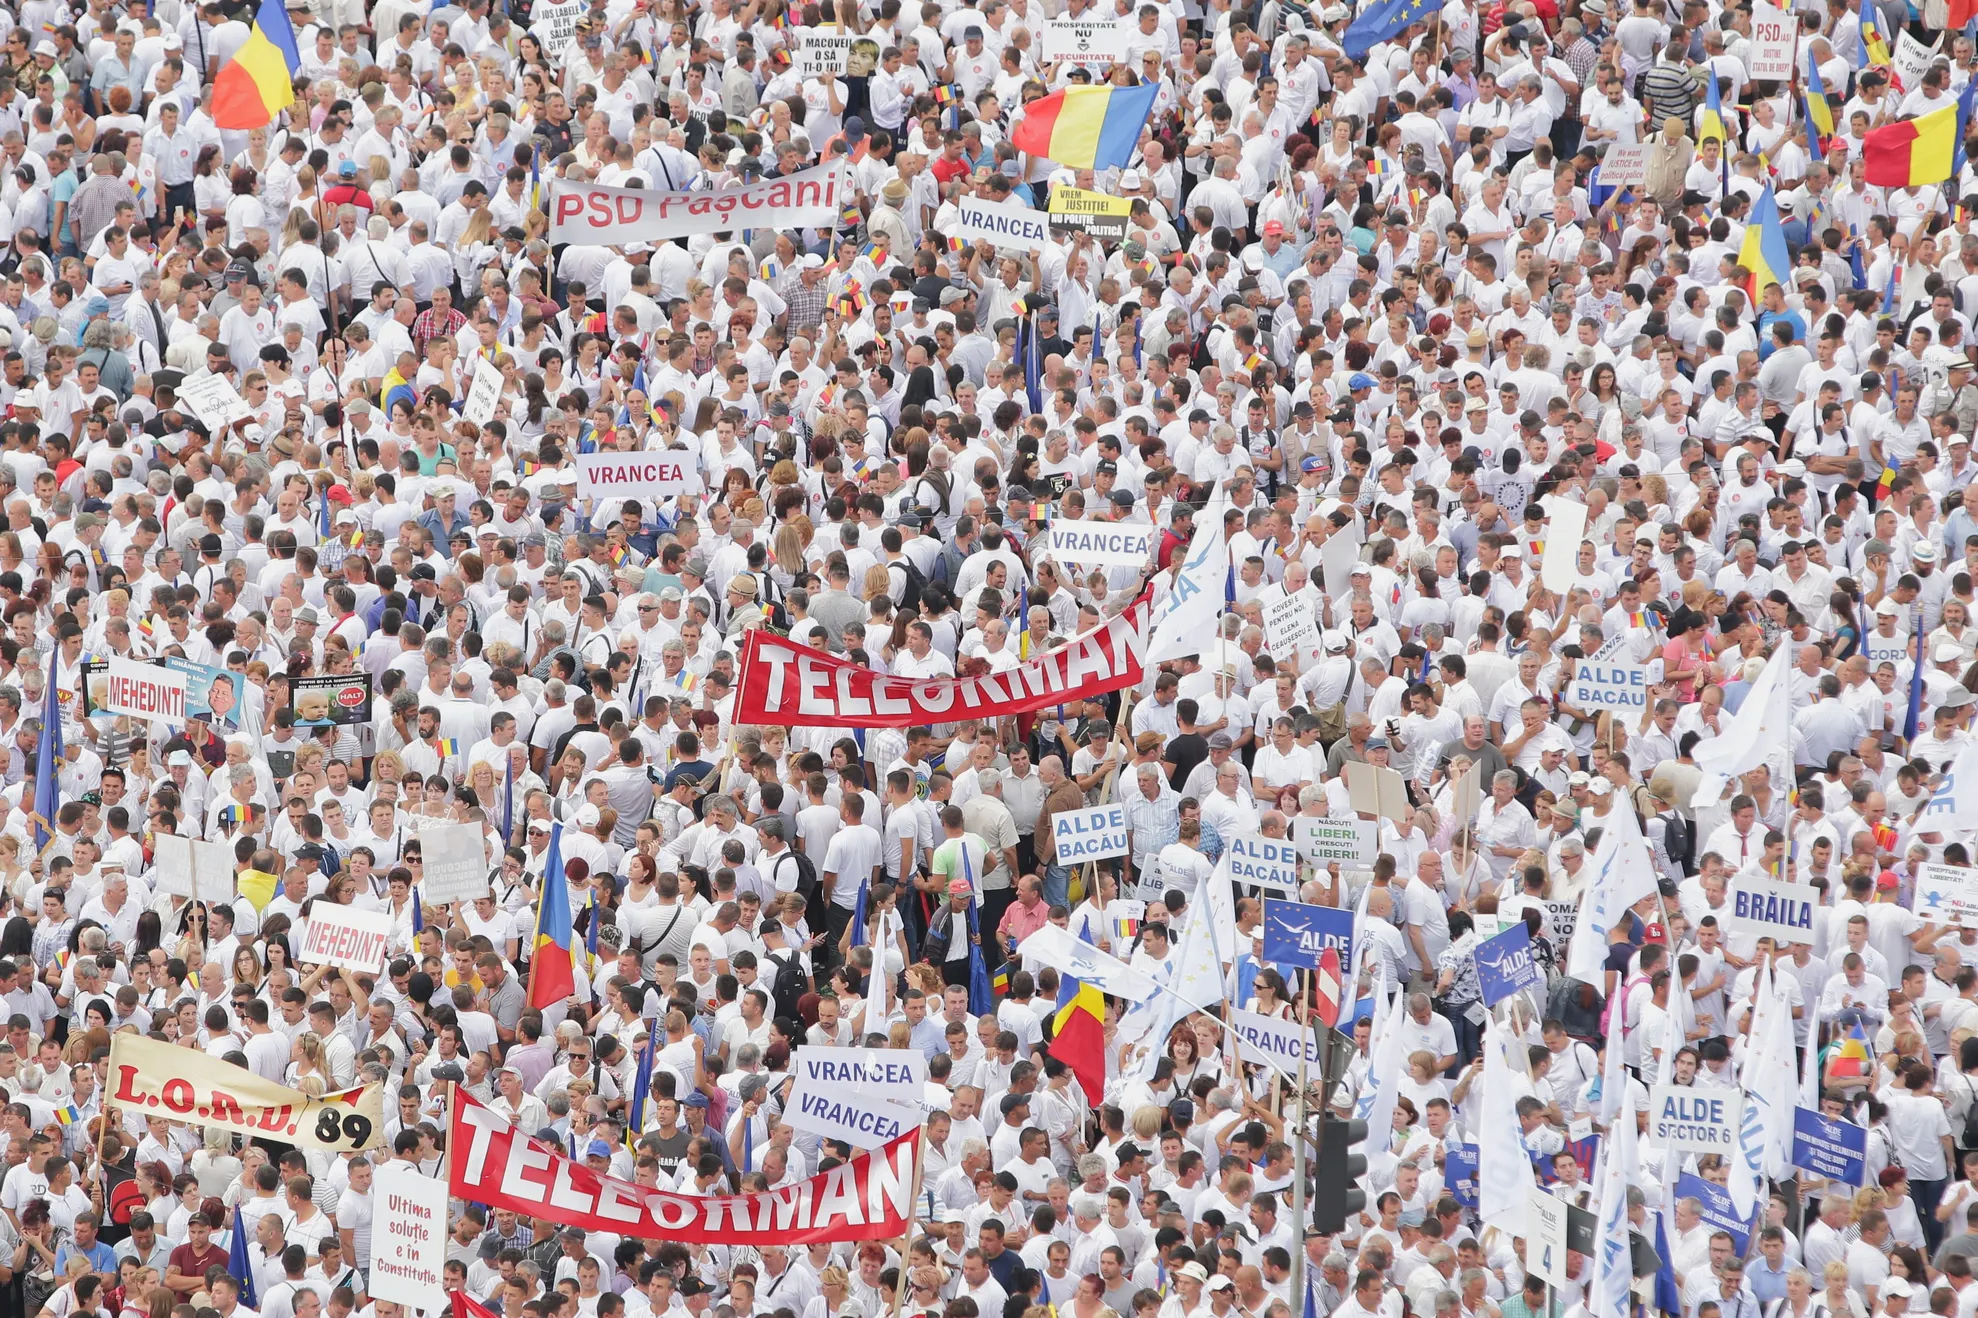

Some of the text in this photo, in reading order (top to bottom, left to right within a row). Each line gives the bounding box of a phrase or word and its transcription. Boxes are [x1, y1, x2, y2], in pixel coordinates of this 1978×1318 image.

[555, 5, 579, 18] LABELE
[553, 17, 571, 28] DE PE
[1075, 30, 1092, 38] NU
[1756, 23, 1781, 42] PSD
[815, 49, 836, 60] O SĂ
[1902, 39, 1928, 59] Ultima
[1752, 62, 1790, 73] STATUL DE DREPT
[1617, 149, 1642, 157] We want
[1608, 159, 1643, 169] JUSTICE not
[1600, 170, 1643, 181] political police
[1060, 190, 1082, 199] VREM
[556, 191, 642, 228] PSD
[1065, 199, 1109, 213] JUSTIȚIE!
[961, 208, 1045, 241] VRANCEA
[1051, 213, 1095, 227] NU POLIȚIE
[1085, 224, 1123, 237] POLITICĂ
[478, 372, 496, 396] Ultima
[588, 464, 684, 485] VRANCEA
[1053, 531, 1148, 555] VRANCEA
[1271, 594, 1300, 615] KOVESI E
[1269, 603, 1307, 628] PENTRU NOI,
[1280, 620, 1299, 635] ELENA
[1869, 650, 1907, 660] GORJ
[1578, 666, 1643, 686] ALDE
[109, 676, 185, 718] MEHEDINTI
[340, 692, 362, 700] HALT
[1578, 688, 1645, 706] BACĂU
[1927, 773, 1955, 815] DE
[1057, 810, 1124, 836] ALDE
[1318, 819, 1351, 827] NĂSCUȚI
[1311, 828, 1360, 842] LIBERI,
[1315, 840, 1352, 848] CRESCUȚI
[1059, 834, 1126, 858] BACĂU
[1231, 838, 1294, 864] ALDE
[1311, 849, 1359, 860] LIBERI!
[1169, 865, 1188, 876] ALDE
[1231, 860, 1294, 885] BACĂU
[1735, 890, 1812, 929] BRĂILA
[304, 920, 388, 966] MEHEDINTI
[1300, 931, 1350, 954] ALDE
[1363, 929, 1376, 939] DE
[1502, 946, 1532, 977] ALDE
[807, 1060, 913, 1084] VRANCEA
[801, 1092, 900, 1139] VRANCEA
[1663, 1095, 1724, 1124] ALDE
[315, 1107, 372, 1149] 89
[1658, 1122, 1731, 1144] SECTOR 6
[1824, 1124, 1842, 1137] ALDE
[660, 1156, 678, 1167] EARĂ
[1459, 1151, 1477, 1159] ALDE
[460, 1103, 914, 1232] TELEORMAN
[389, 1194, 431, 1219] Ultima
[1712, 1193, 1731, 1208] ALDE
[1541, 1209, 1557, 1225] ALDE
[389, 1220, 429, 1244] soluție
[396, 1244, 420, 1261] e în
[1543, 1244, 1552, 1275] 4
[377, 1258, 436, 1287] Constituție
